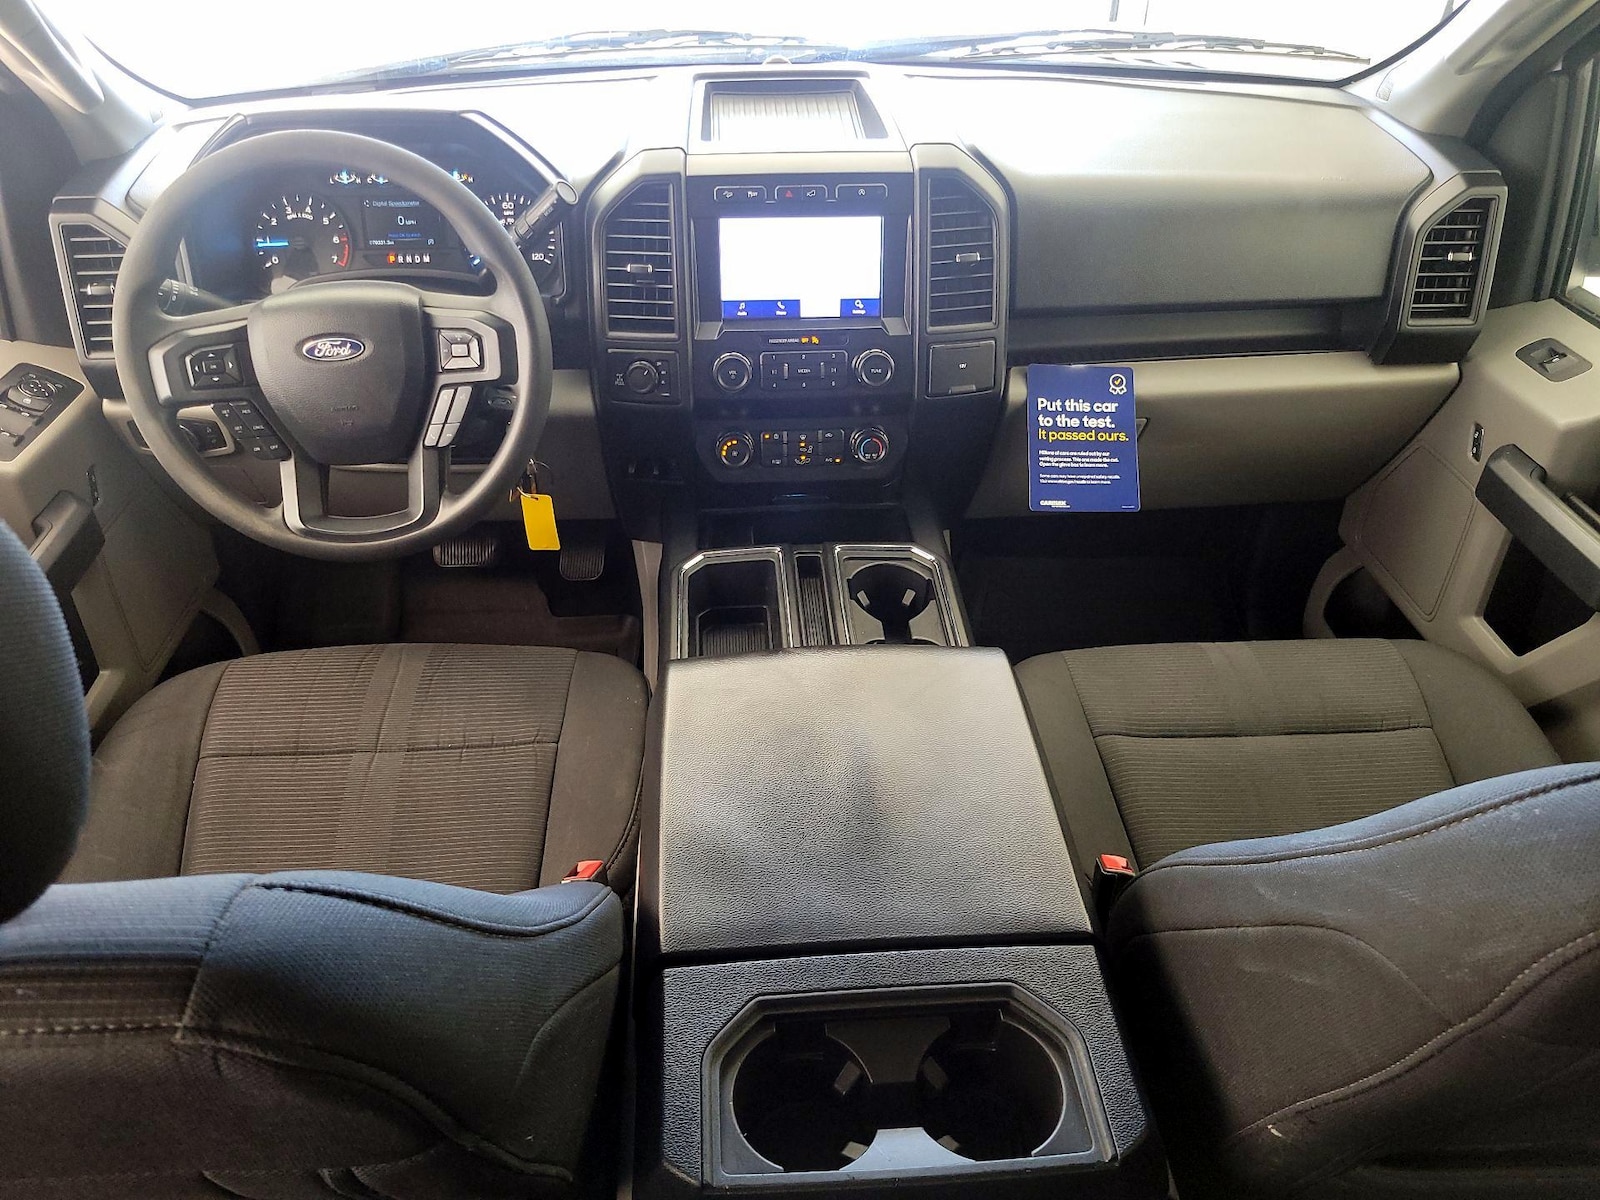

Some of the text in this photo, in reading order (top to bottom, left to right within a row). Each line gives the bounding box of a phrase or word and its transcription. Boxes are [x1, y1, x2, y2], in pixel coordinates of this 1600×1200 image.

[285, 205, 292, 214] 3
[305, 205, 312, 214] 4
[270, 217, 278, 226] 2
[322, 217, 330, 225] 5
[397, 215, 405, 226] 0
[332, 235, 340, 244] 6
[271, 255, 279, 264] 0
[331, 253, 338, 263] 7
[397, 253, 405, 263] R
[405, 253, 413, 263] N
[414, 253, 421, 263] D
[422, 253, 431, 263] M
[531, 253, 545, 261] 120
[314, 340, 352, 357] Ford
[1037, 397, 1119, 413] Put this car
[1038, 414, 1116, 429] to the test.
[1038, 428, 1129, 443] It passed ours.
